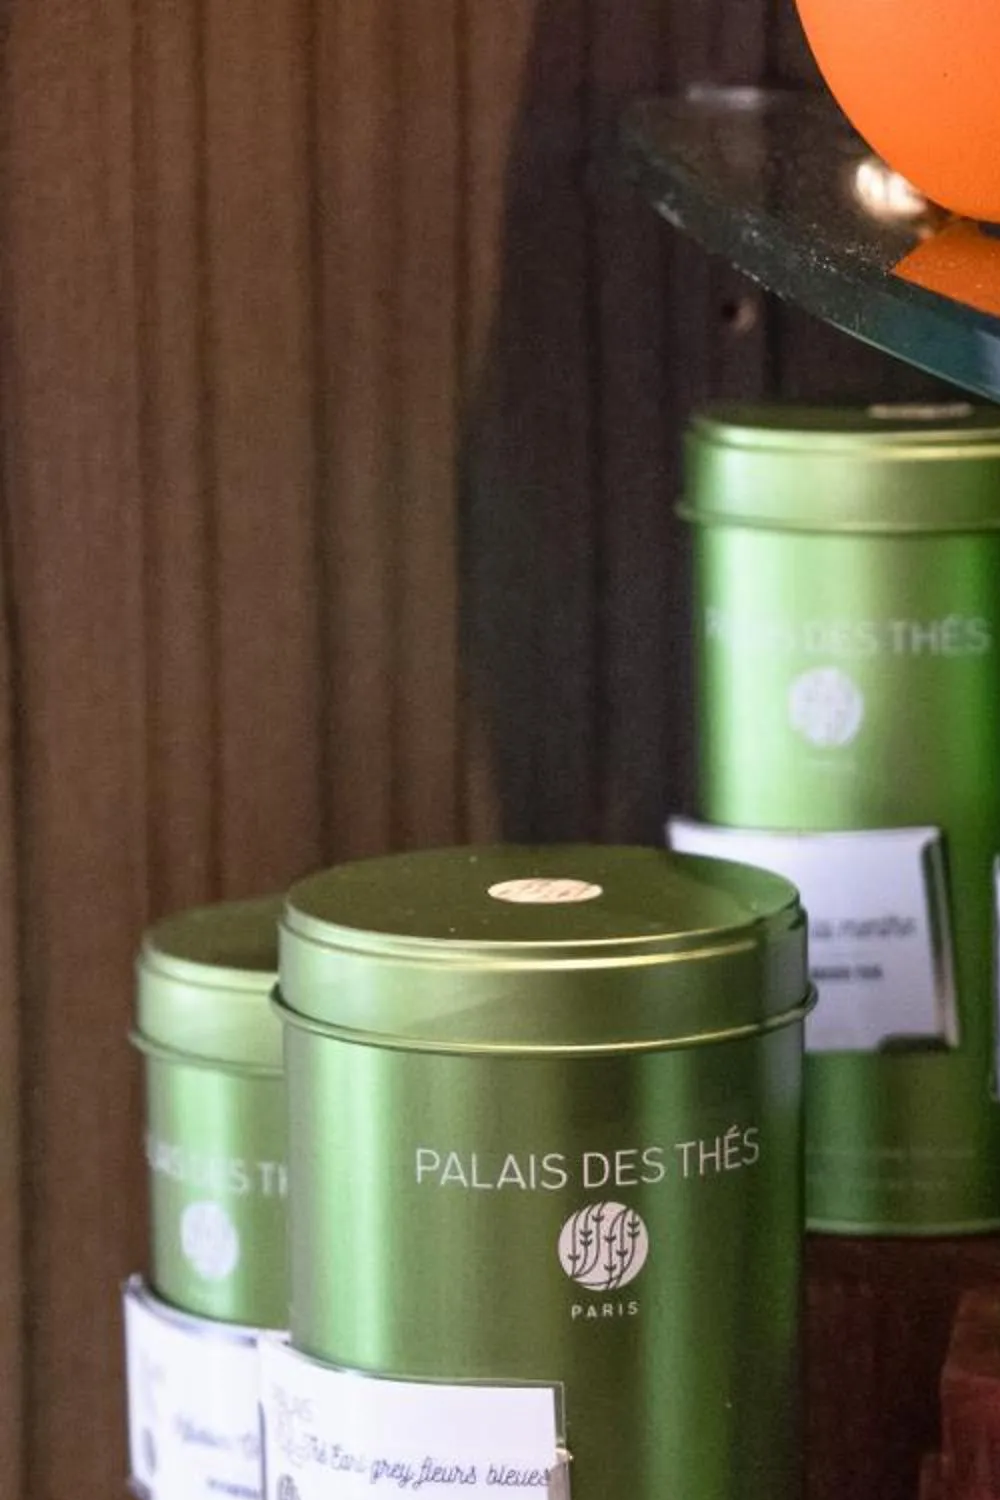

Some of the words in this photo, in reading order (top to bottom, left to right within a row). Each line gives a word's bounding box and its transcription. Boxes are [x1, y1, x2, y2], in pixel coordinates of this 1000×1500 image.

[888, 612, 992, 658] THÉS
[416, 1147, 568, 1190] PALAIS
[582, 1146, 666, 1189] DES
[677, 1124, 760, 1179] THÉS
[571, 1301, 640, 1319] PARIS
[370, 1458, 414, 1489] grey
[413, 1456, 477, 1491] fleurs
[485, 1463, 551, 1487] bleues
